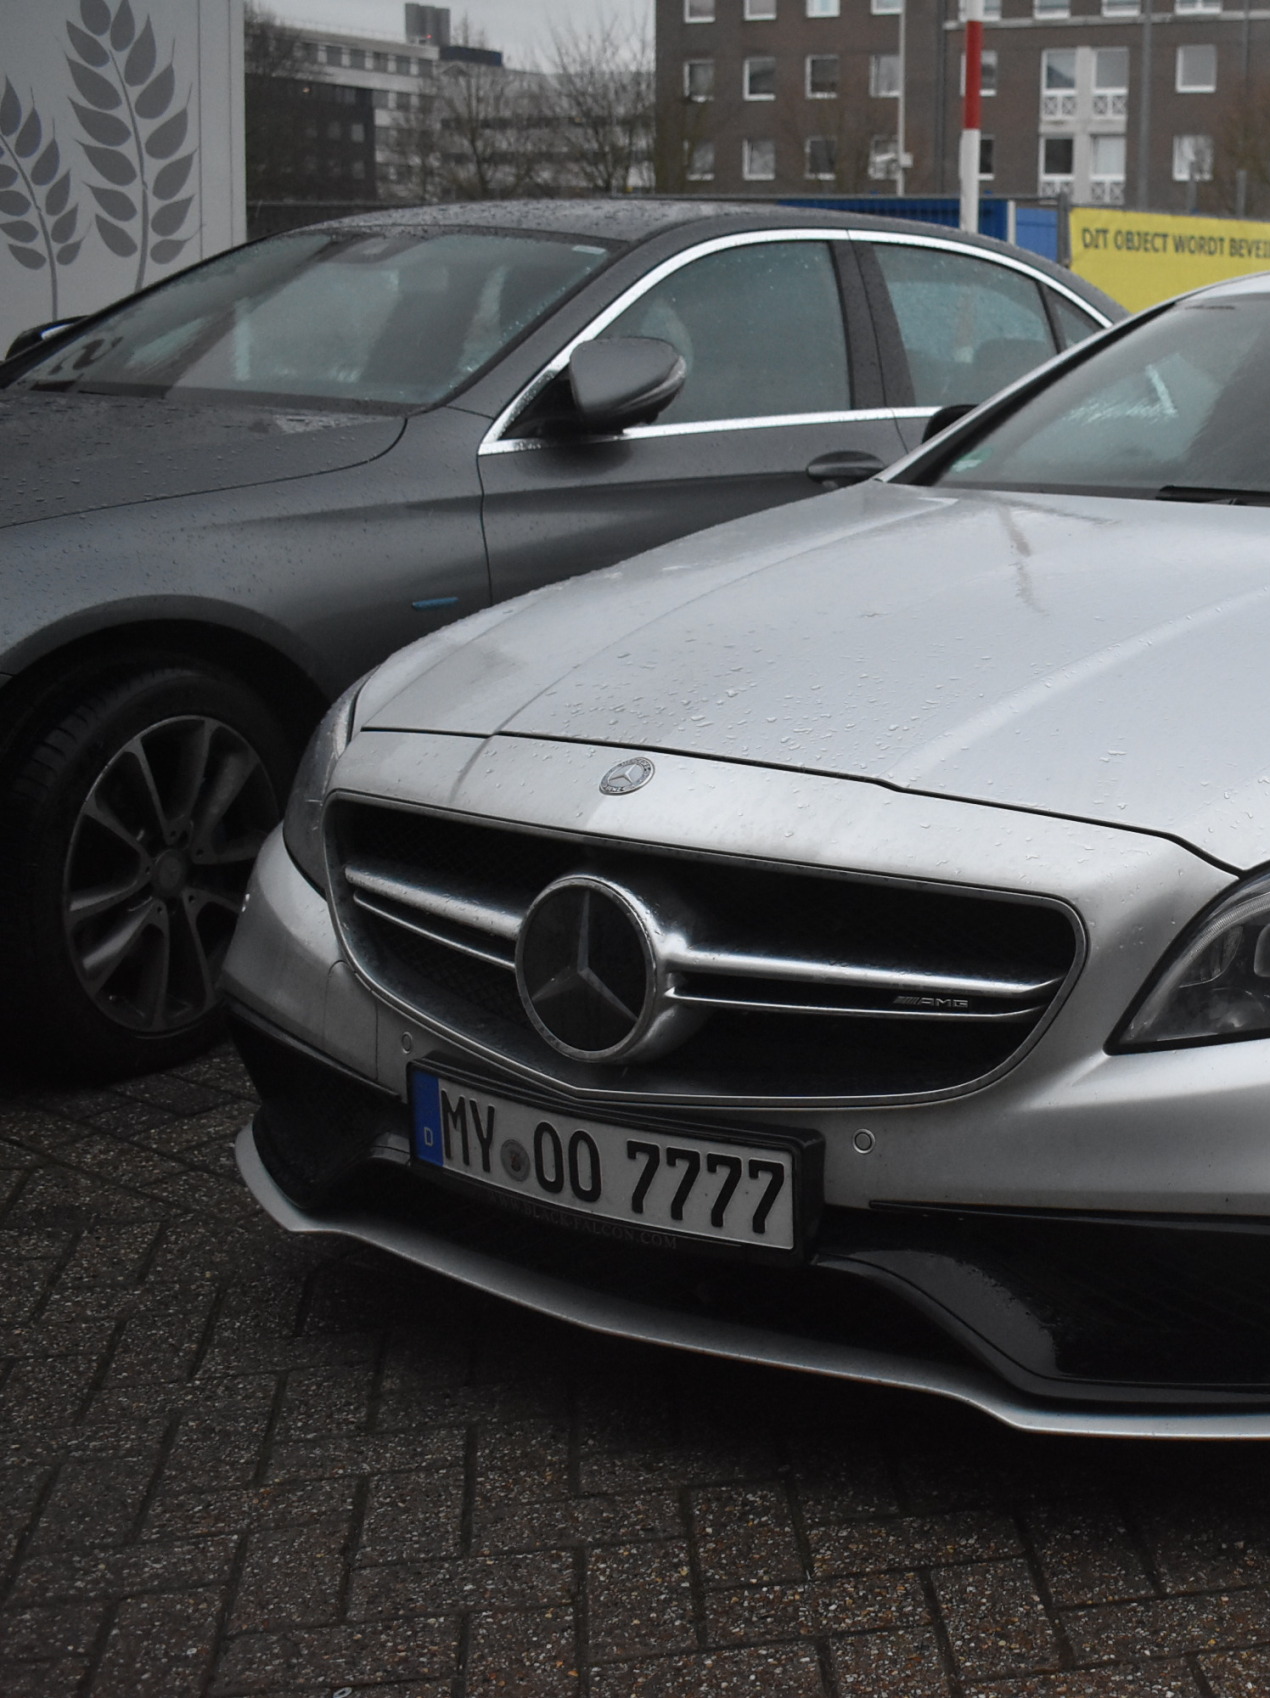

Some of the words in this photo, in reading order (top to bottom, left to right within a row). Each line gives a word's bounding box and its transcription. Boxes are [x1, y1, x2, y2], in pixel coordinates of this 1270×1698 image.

[1082, 228, 1109, 249] DIT
[1114, 230, 1170, 253] OBJECT
[1174, 233, 1224, 256] WORDT
[919, 996, 969, 1008] AMG
[424, 1127, 433, 1146] D
[441, 1089, 495, 1173] MY
[627, 1139, 785, 1234] 7777
